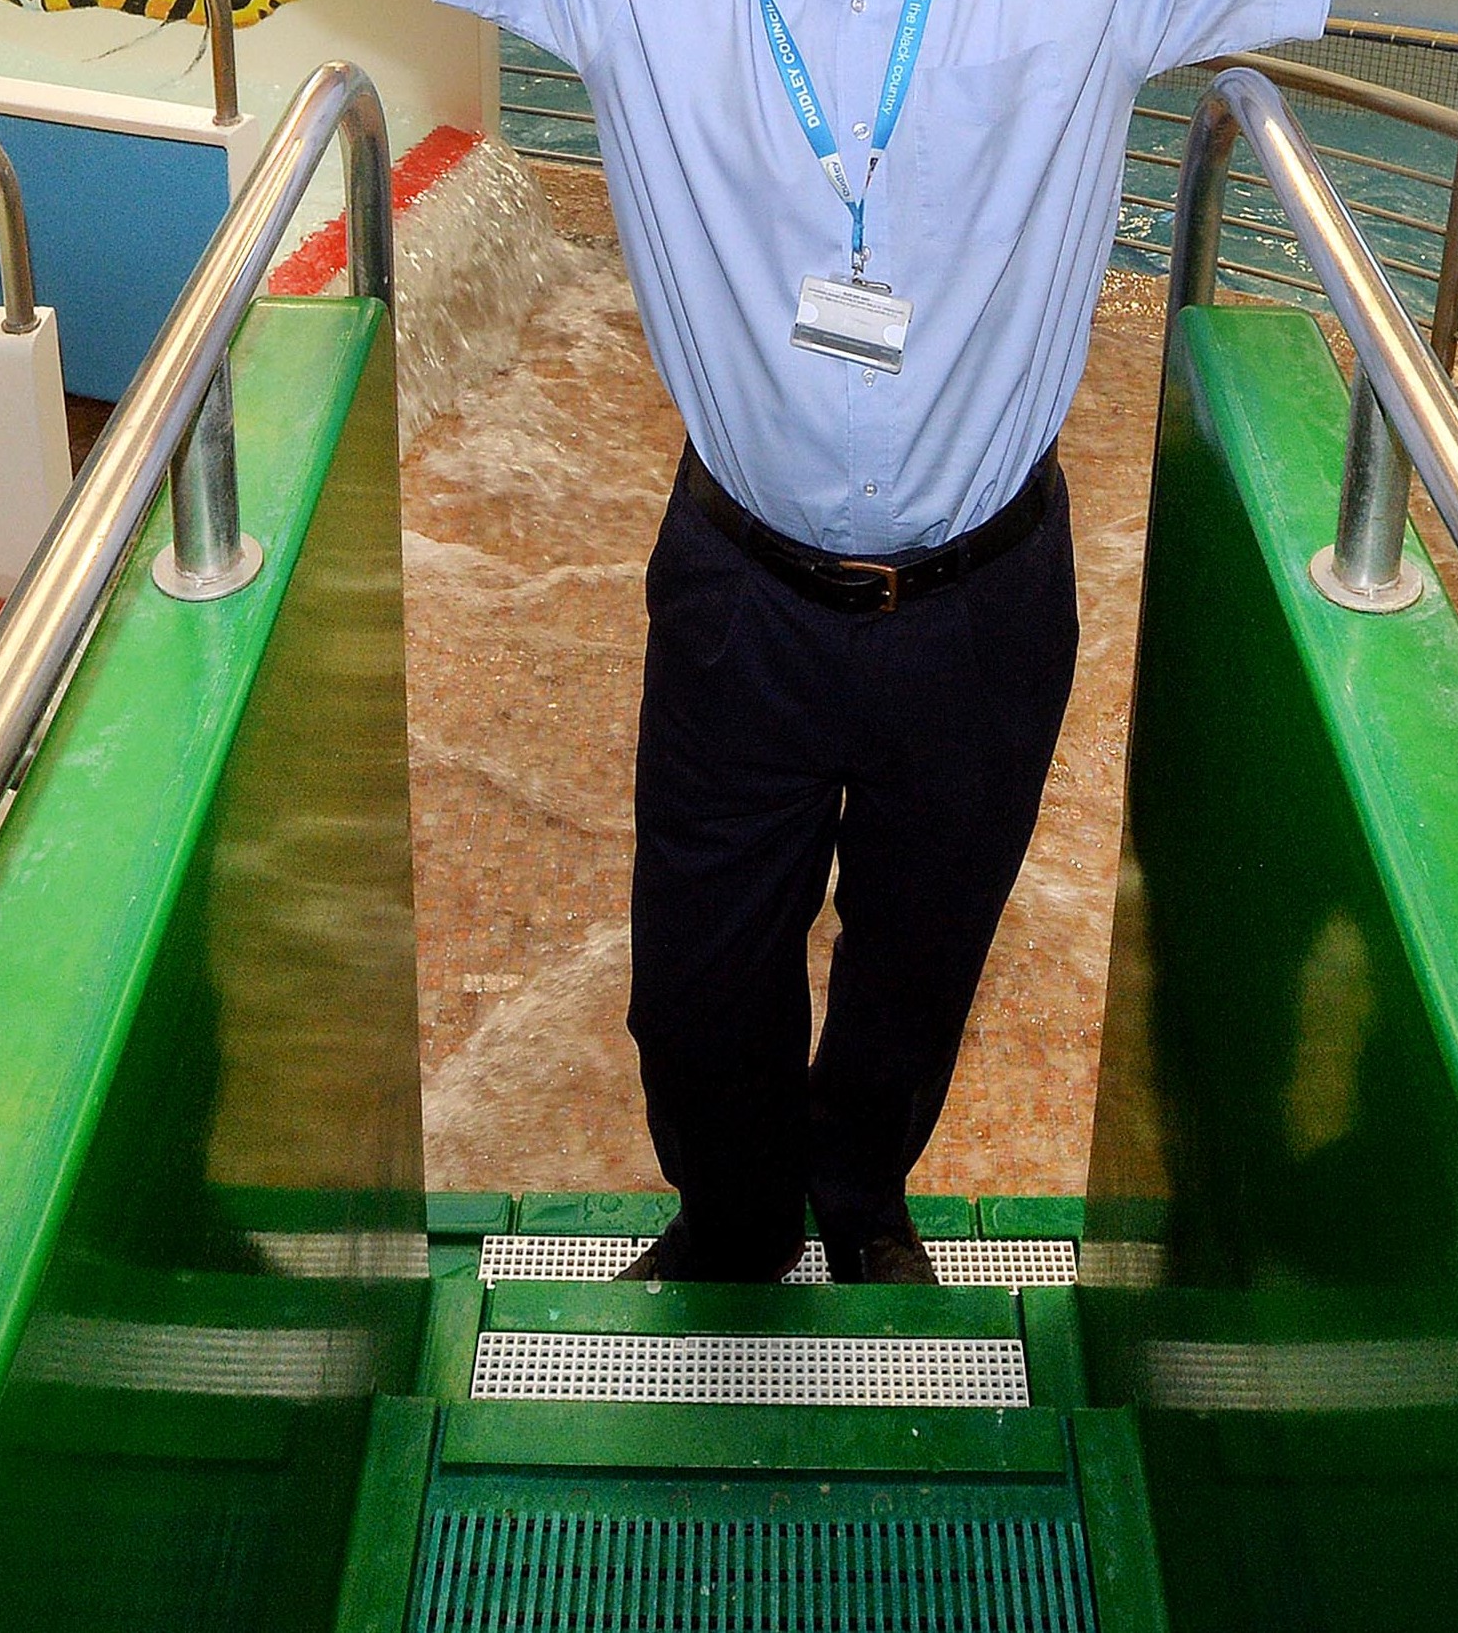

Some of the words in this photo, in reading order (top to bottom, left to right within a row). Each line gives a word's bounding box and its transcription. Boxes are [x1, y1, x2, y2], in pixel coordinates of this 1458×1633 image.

[765, 1, 796, 64] COUNCIL
[906, 2, 921, 24] the
[897, 26, 917, 63] black
[787, 68, 821, 130] DUDLEY
[882, 64, 904, 115] country
